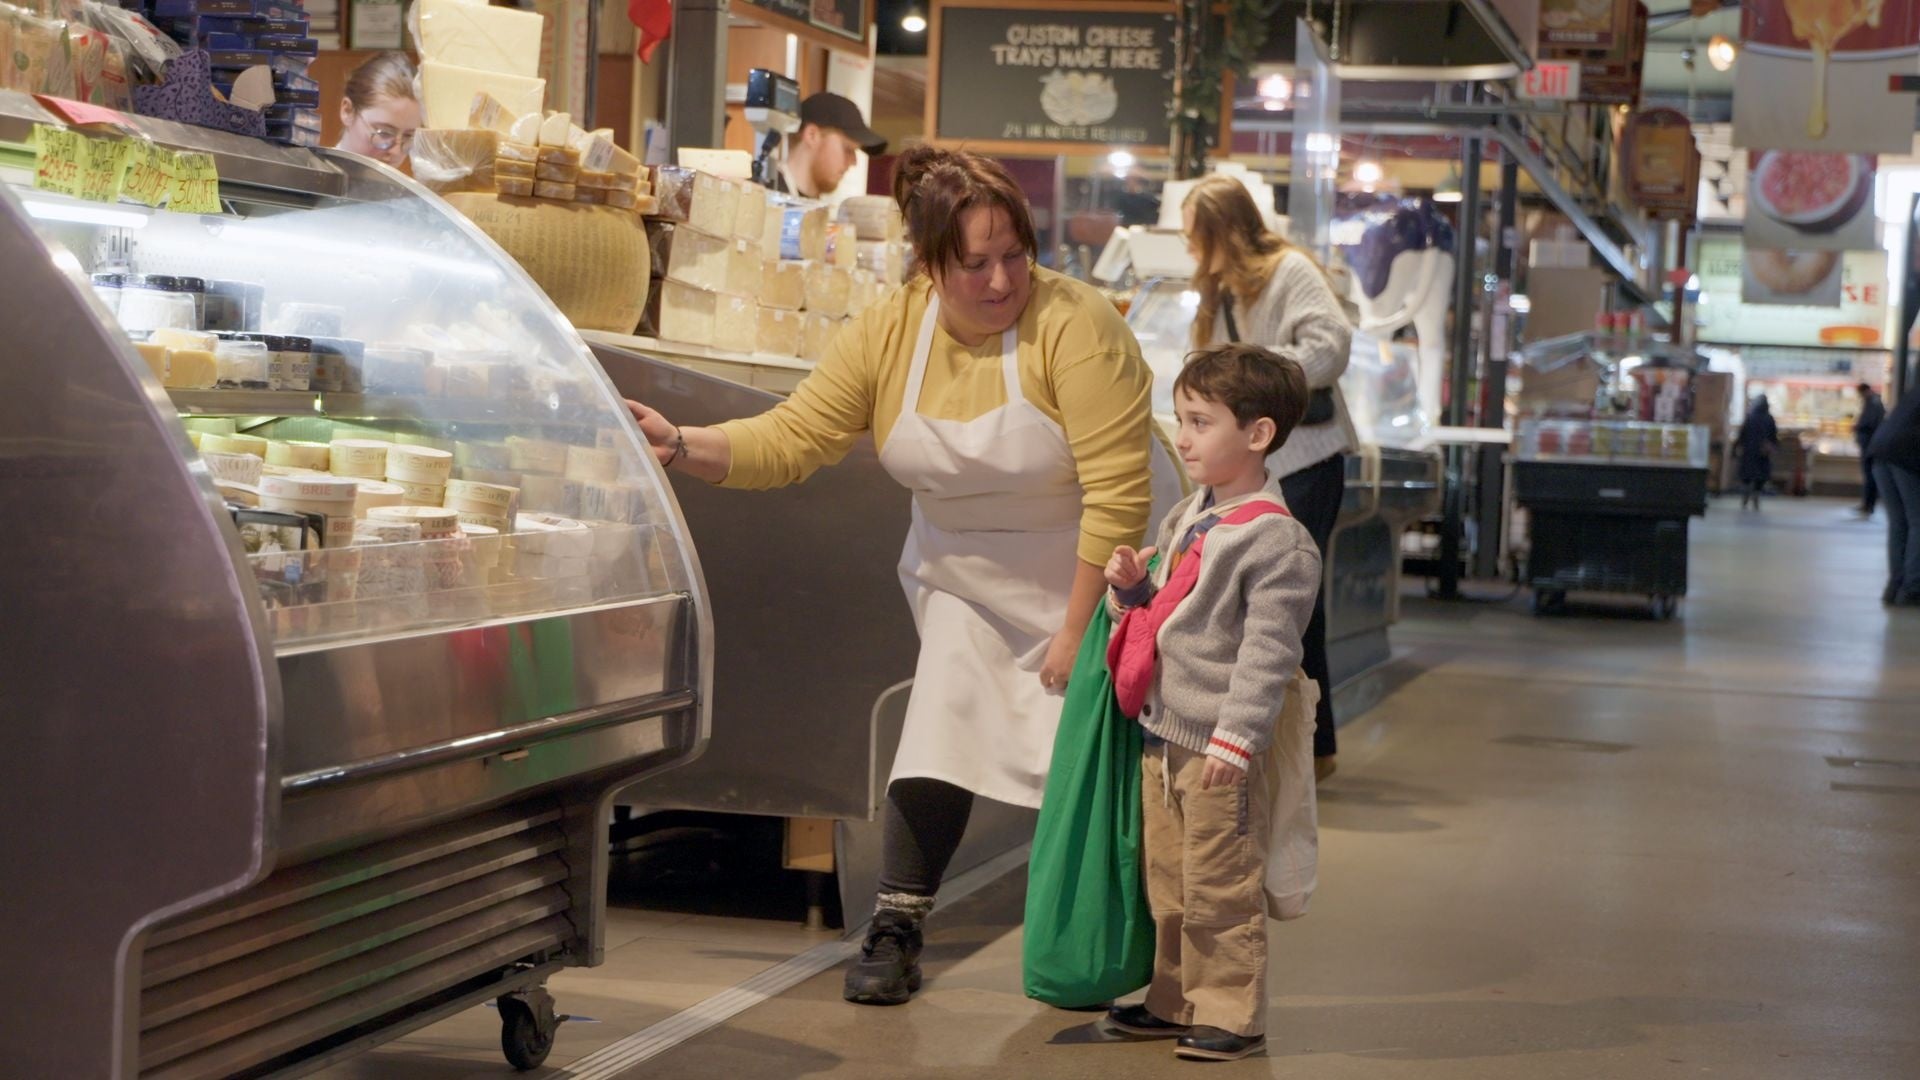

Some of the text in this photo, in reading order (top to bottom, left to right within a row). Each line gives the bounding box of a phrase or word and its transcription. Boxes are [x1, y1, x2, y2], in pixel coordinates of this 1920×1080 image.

[1007, 24, 1155, 48] CUSTOM CHEESE
[991, 44, 1162, 70] TRAYS MADE HERE
[1524, 65, 1570, 96] EXIT
[302, 485, 332, 496] BRIE
